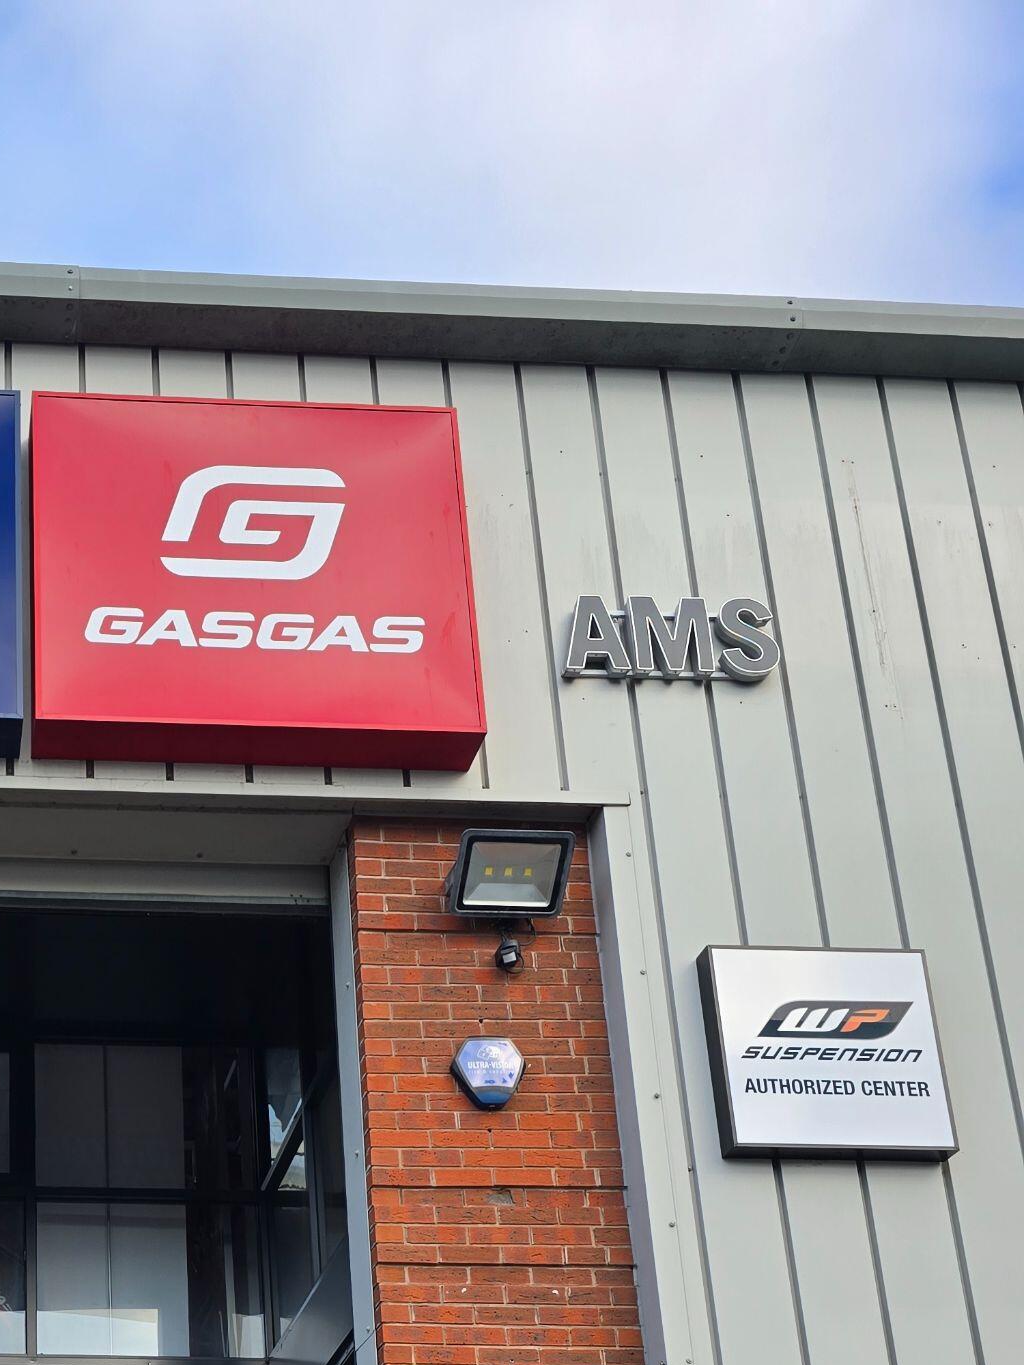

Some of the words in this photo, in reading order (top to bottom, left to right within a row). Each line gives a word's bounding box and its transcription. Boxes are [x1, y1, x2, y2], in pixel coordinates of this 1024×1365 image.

[84, 606, 426, 653] GASGAS
[564, 594, 781, 677] AMS
[775, 1005, 891, 1034] WP
[741, 1046, 923, 1063] SUSPENSION
[744, 1077, 856, 1096] AUTHORIZED
[861, 1080, 931, 1097] CENTER
